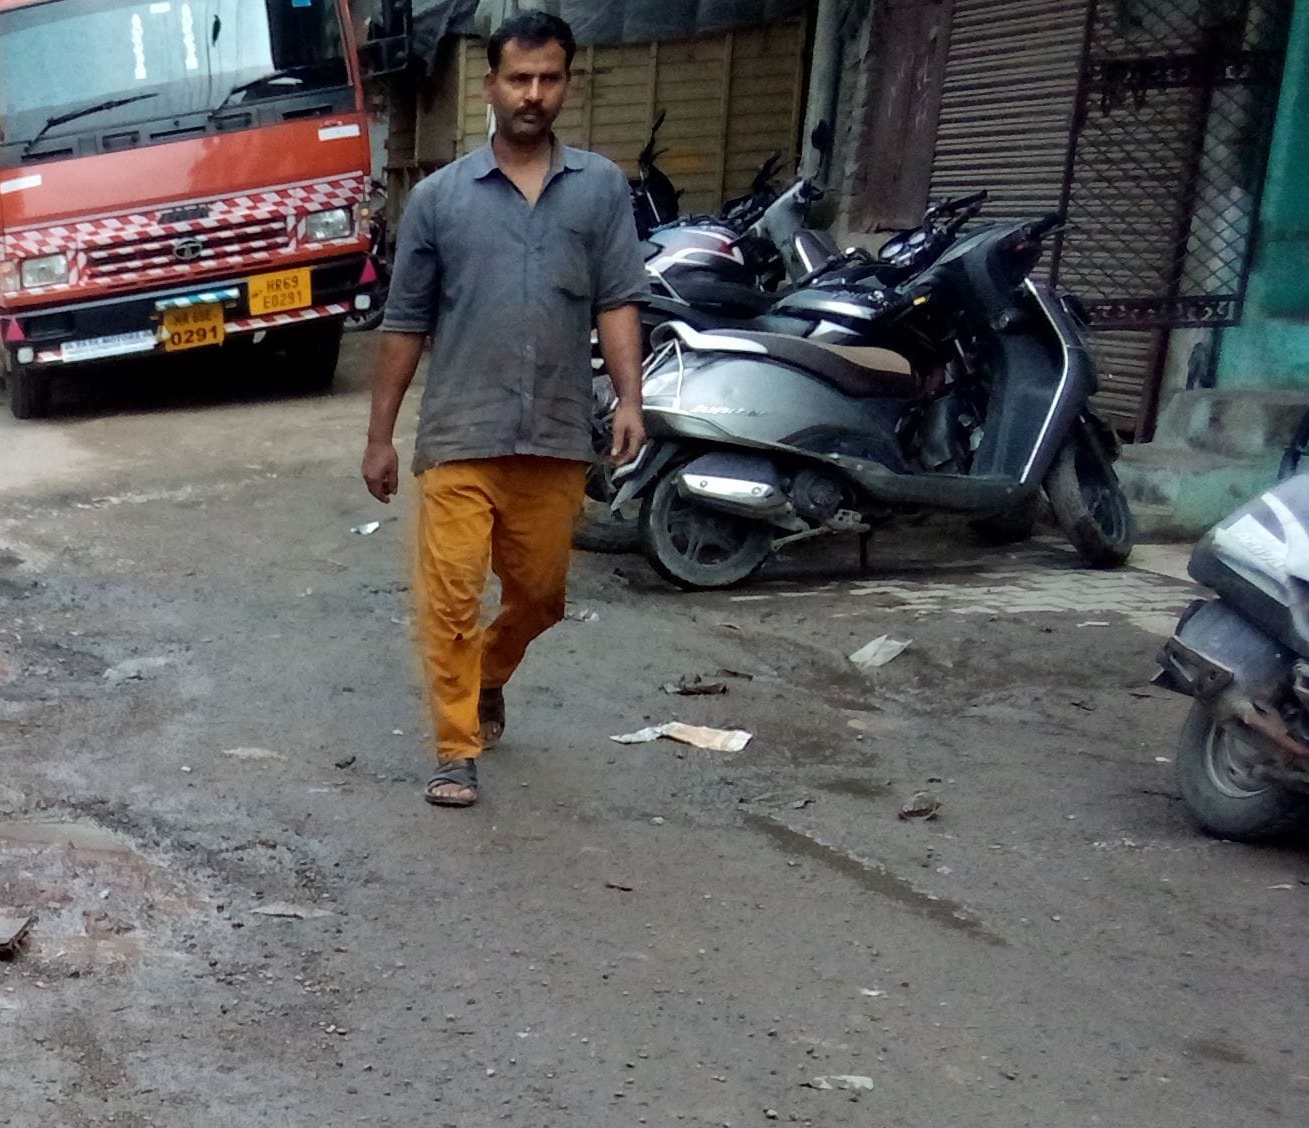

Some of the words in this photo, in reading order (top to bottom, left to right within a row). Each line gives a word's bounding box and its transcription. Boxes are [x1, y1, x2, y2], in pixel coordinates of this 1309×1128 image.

[266, 275, 299, 293] HR69
[263, 290, 303, 309] E0291
[171, 325, 218, 346] 0291
